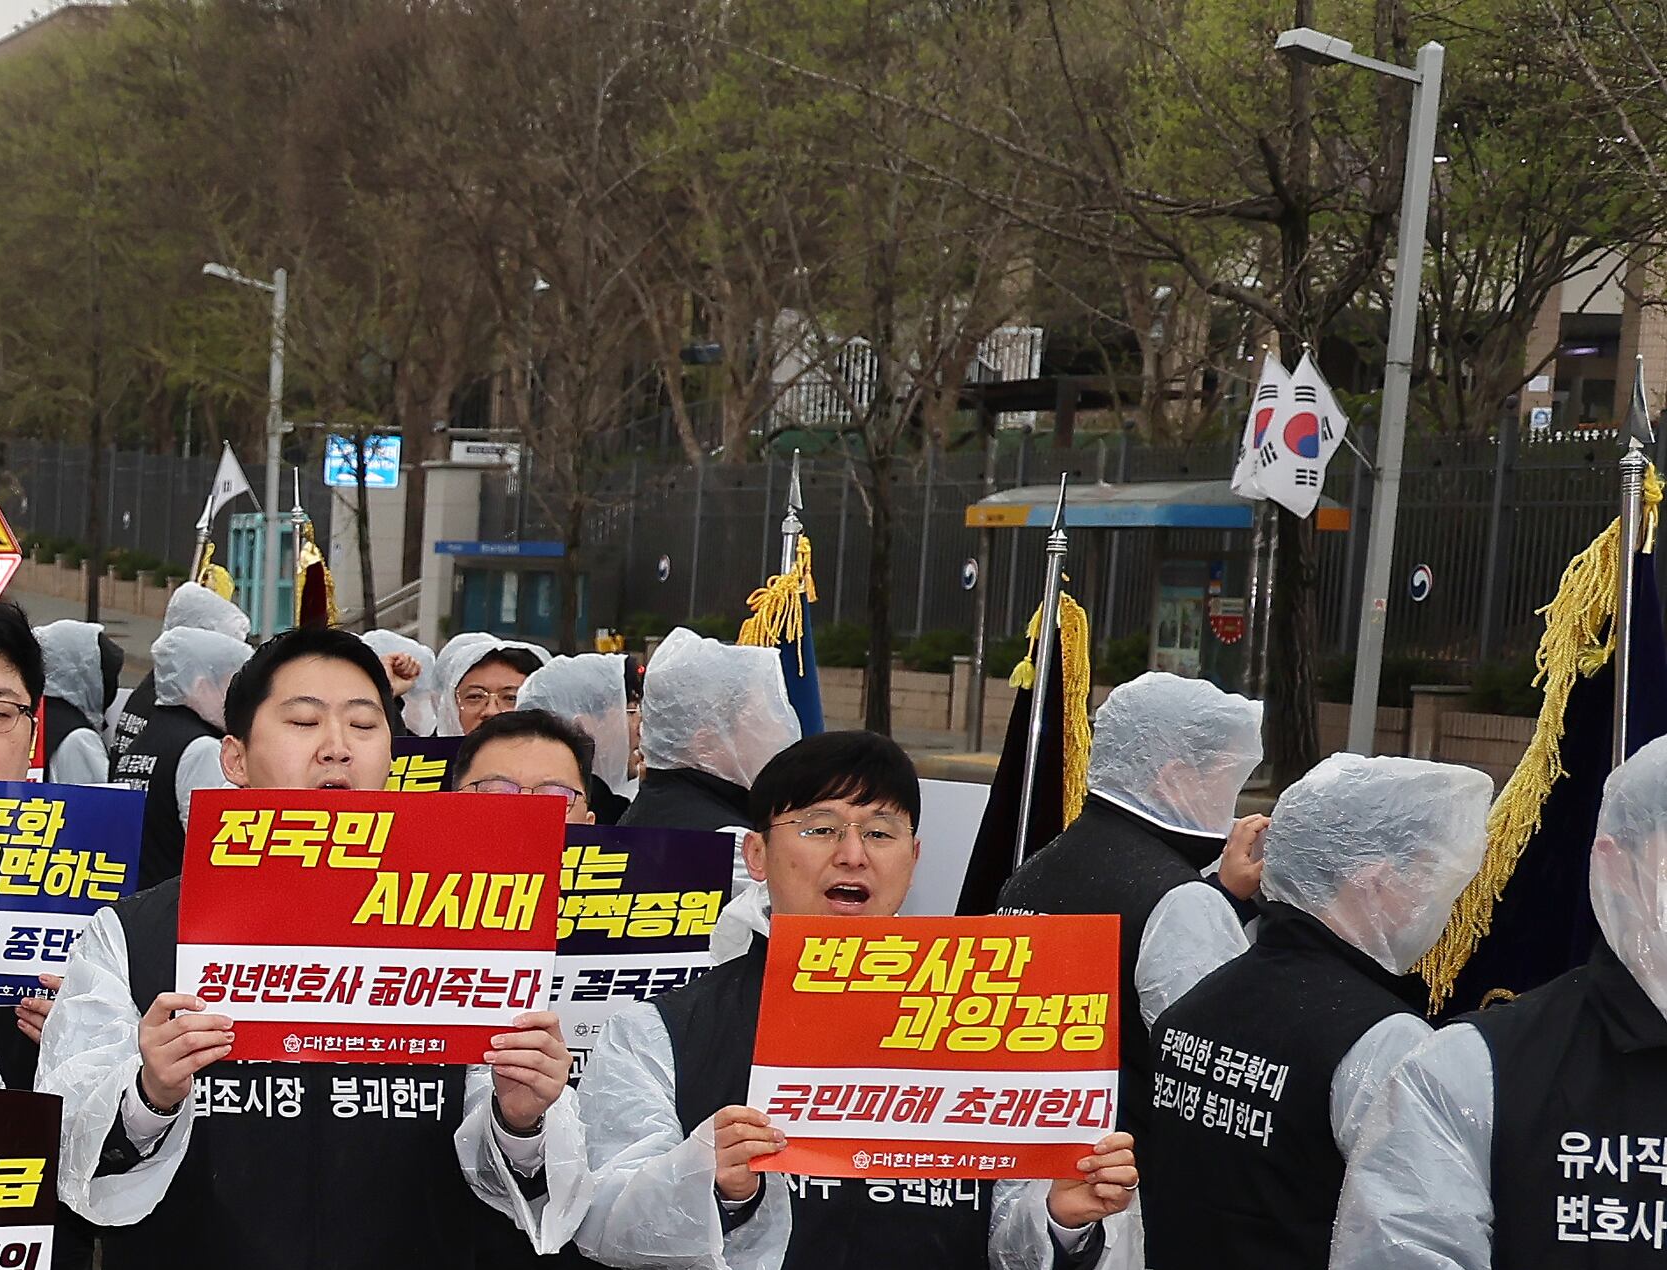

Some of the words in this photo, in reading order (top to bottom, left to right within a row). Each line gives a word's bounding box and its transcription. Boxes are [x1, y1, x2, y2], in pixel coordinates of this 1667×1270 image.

[209, 809, 395, 869] 전국민
[352, 871, 545, 932] AI시대
[3, 926, 83, 962] 중단
[792, 935, 1033, 995] 변호사간
[196, 962, 365, 1005] 청년변호사
[367, 965, 542, 1009] 굶어죽는다
[303, 1036, 446, 1054] 대한변호사협회
[879, 994, 1109, 1052] 과잉경쟁
[1161, 1028, 1213, 1076] 무책임한
[1212, 1045, 1289, 1102] 공급확대
[330, 1077, 445, 1121] 붕괴한다
[766, 1084, 945, 1124] 국민피해
[943, 1086, 1114, 1130] 초래한다
[1202, 1091, 1274, 1147] 붕괴한다
[872, 1152, 1017, 1171] 대한변호사협회
